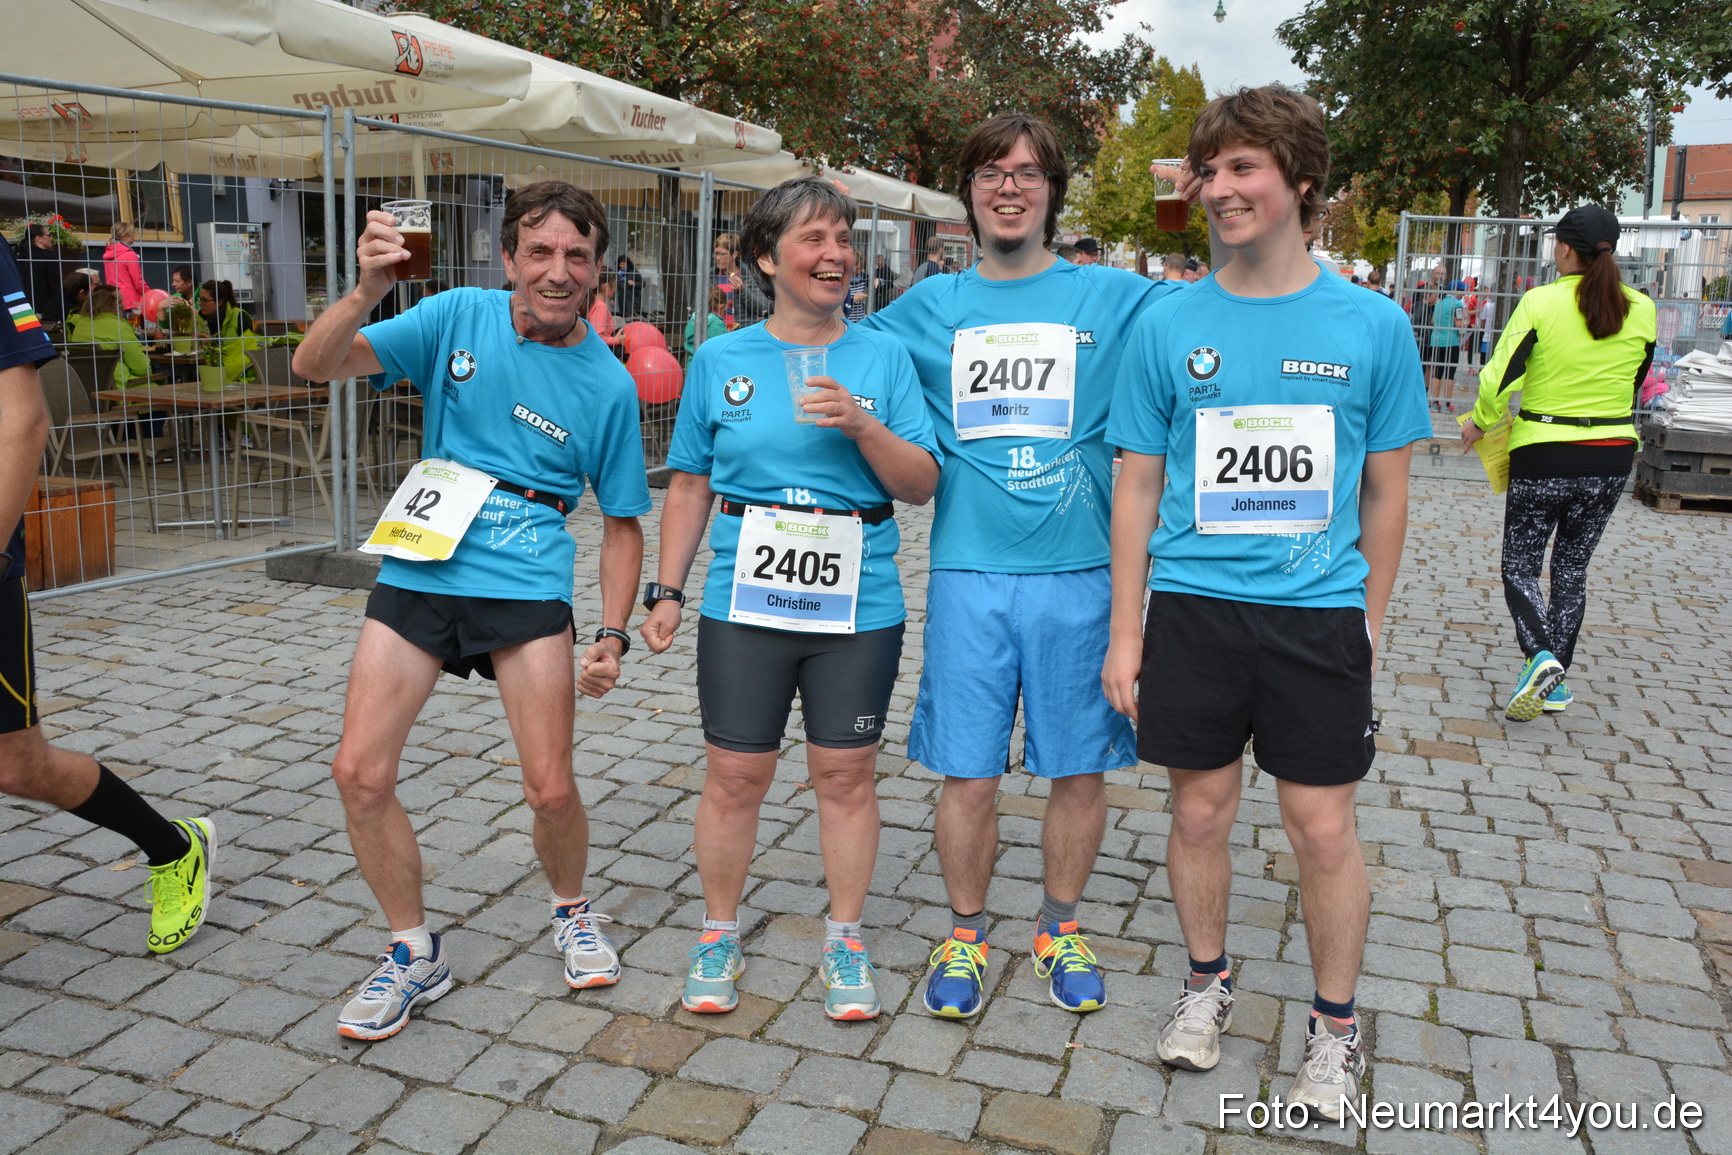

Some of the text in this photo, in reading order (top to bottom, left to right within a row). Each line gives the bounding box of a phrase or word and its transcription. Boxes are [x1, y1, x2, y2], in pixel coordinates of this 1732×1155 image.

[422, 40, 456, 60] PEPE
[631, 104, 666, 131] Tucher
[998, 334, 1039, 344] BOCK
[1076, 330, 1097, 344] CK
[1190, 348, 1219, 360] BMW
[969, 358, 1056, 394] 2407
[1281, 359, 1351, 381] BOCK
[727, 376, 753, 388] BMW
[1189, 383, 1221, 396] PARTL
[721, 409, 752, 418] PARTL
[992, 404, 1029, 416] Moritz
[512, 403, 572, 445] BOCK
[1247, 418, 1293, 429] BOCK
[1007, 446, 1041, 469] 18.
[1008, 450, 1075, 477] Neumarkter
[1216, 445, 1313, 484] 2406
[429, 467, 460, 481] BOCK
[1007, 469, 1065, 490] Stadtlauf
[404, 488, 441, 521] 42
[485, 495, 522, 510] arkter
[781, 487, 818, 505] 18.
[1231, 498, 1296, 511] Johannes
[476, 511, 506, 524] lauf
[388, 526, 422, 544] Herbert
[787, 523, 829, 536] BOCK
[753, 545, 841, 587] 2405
[767, 594, 821, 611] Christine
[149, 904, 203, 946] OOKS
